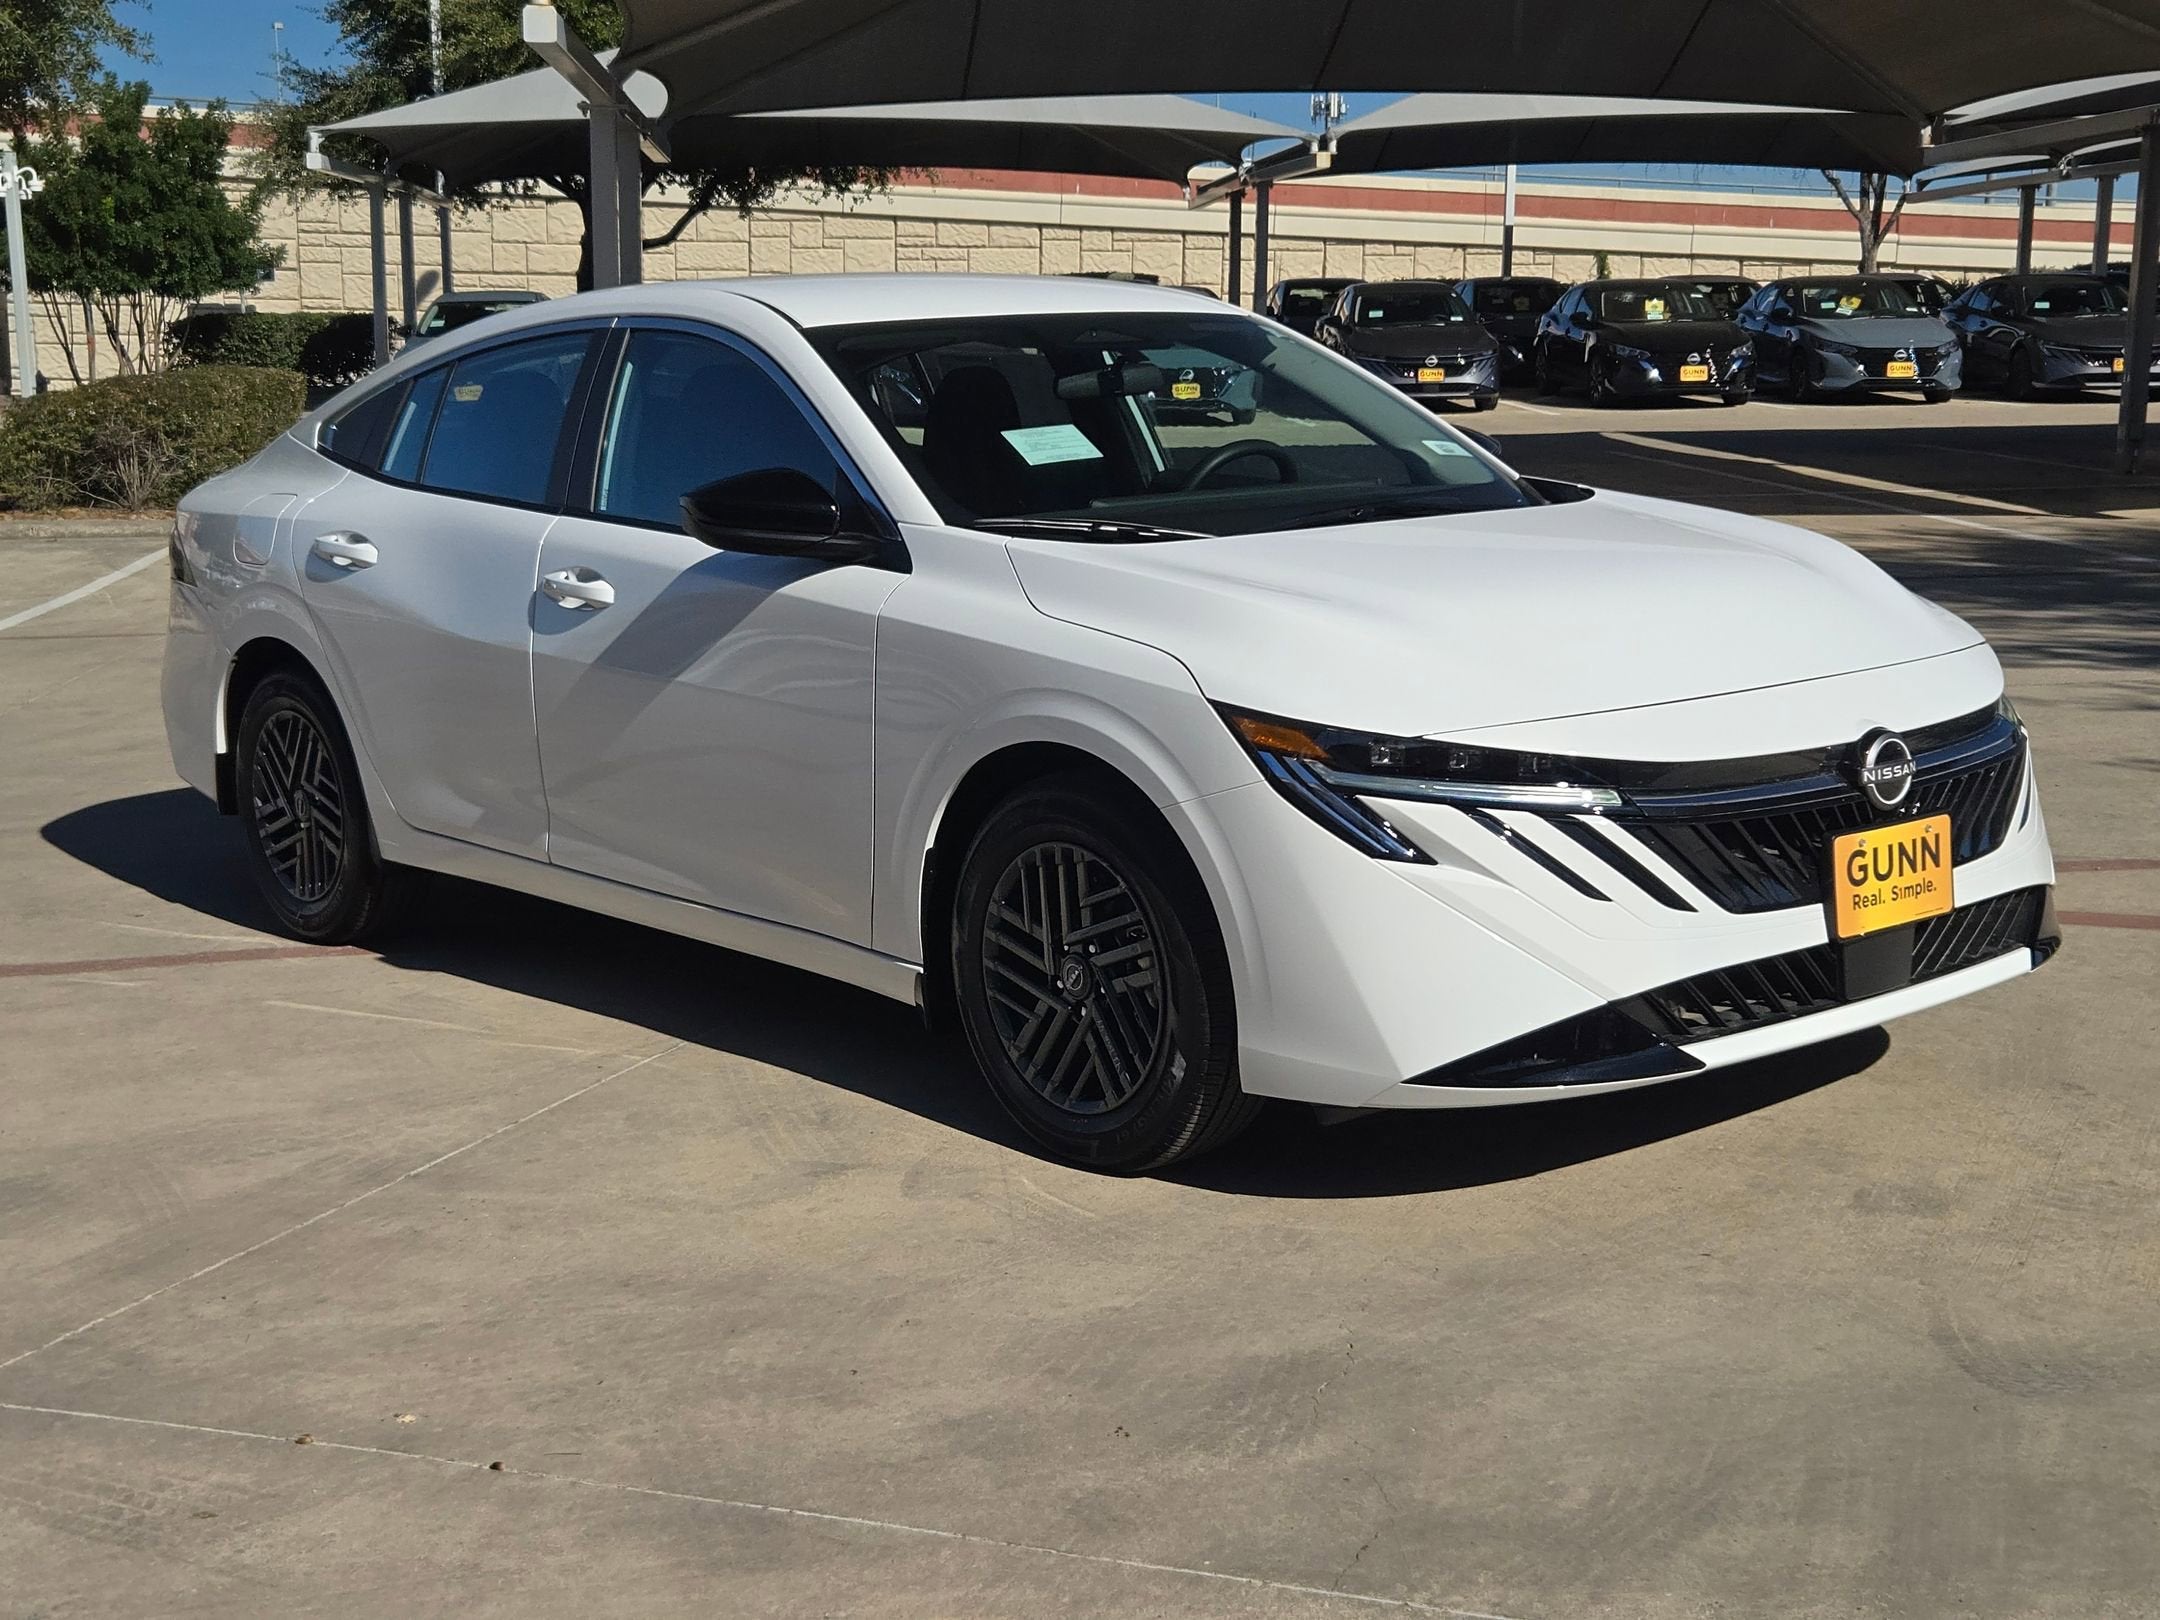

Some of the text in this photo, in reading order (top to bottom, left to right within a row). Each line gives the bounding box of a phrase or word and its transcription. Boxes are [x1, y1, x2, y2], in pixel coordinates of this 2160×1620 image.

[1863, 760, 1917, 783] NISSAN
[1847, 832, 1941, 887] GUNN
[1852, 877, 1937, 911] Real. Simple.
